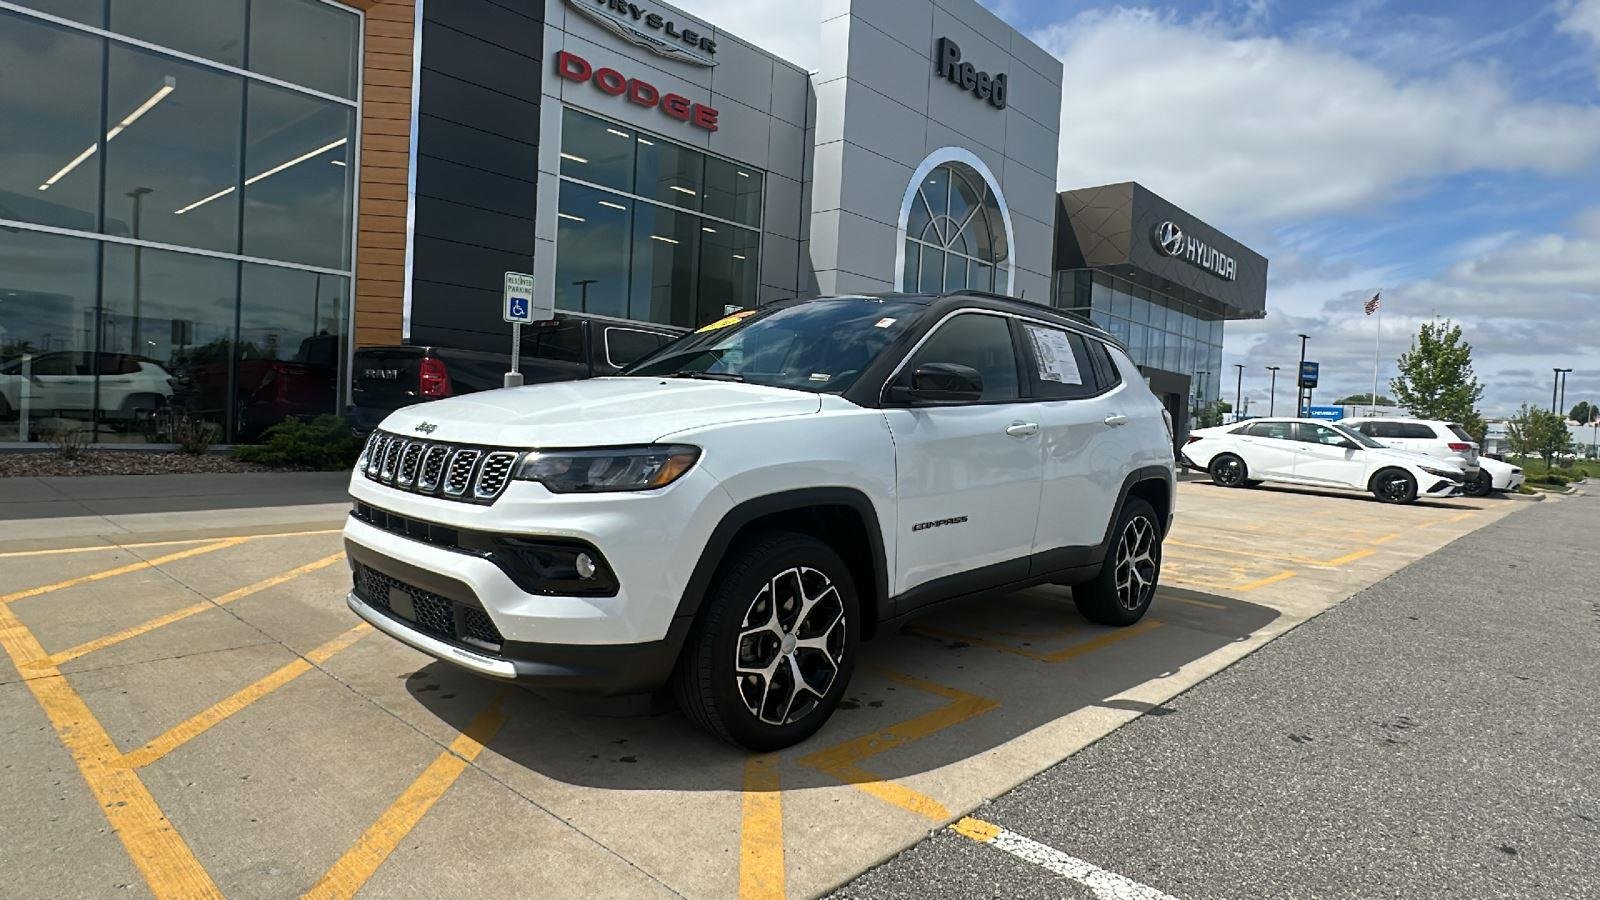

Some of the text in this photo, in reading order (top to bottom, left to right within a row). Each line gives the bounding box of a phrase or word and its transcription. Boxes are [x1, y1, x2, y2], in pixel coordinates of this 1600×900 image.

[937, 36, 1008, 110] Reed
[556, 50, 719, 132] DODGE
[1186, 235, 1237, 281] HYUNDAI
[507, 285, 532, 294] PARKING
[364, 369, 398, 379] RAM
[415, 421, 438, 435] Jeep
[912, 515, 968, 531] COMPASS
